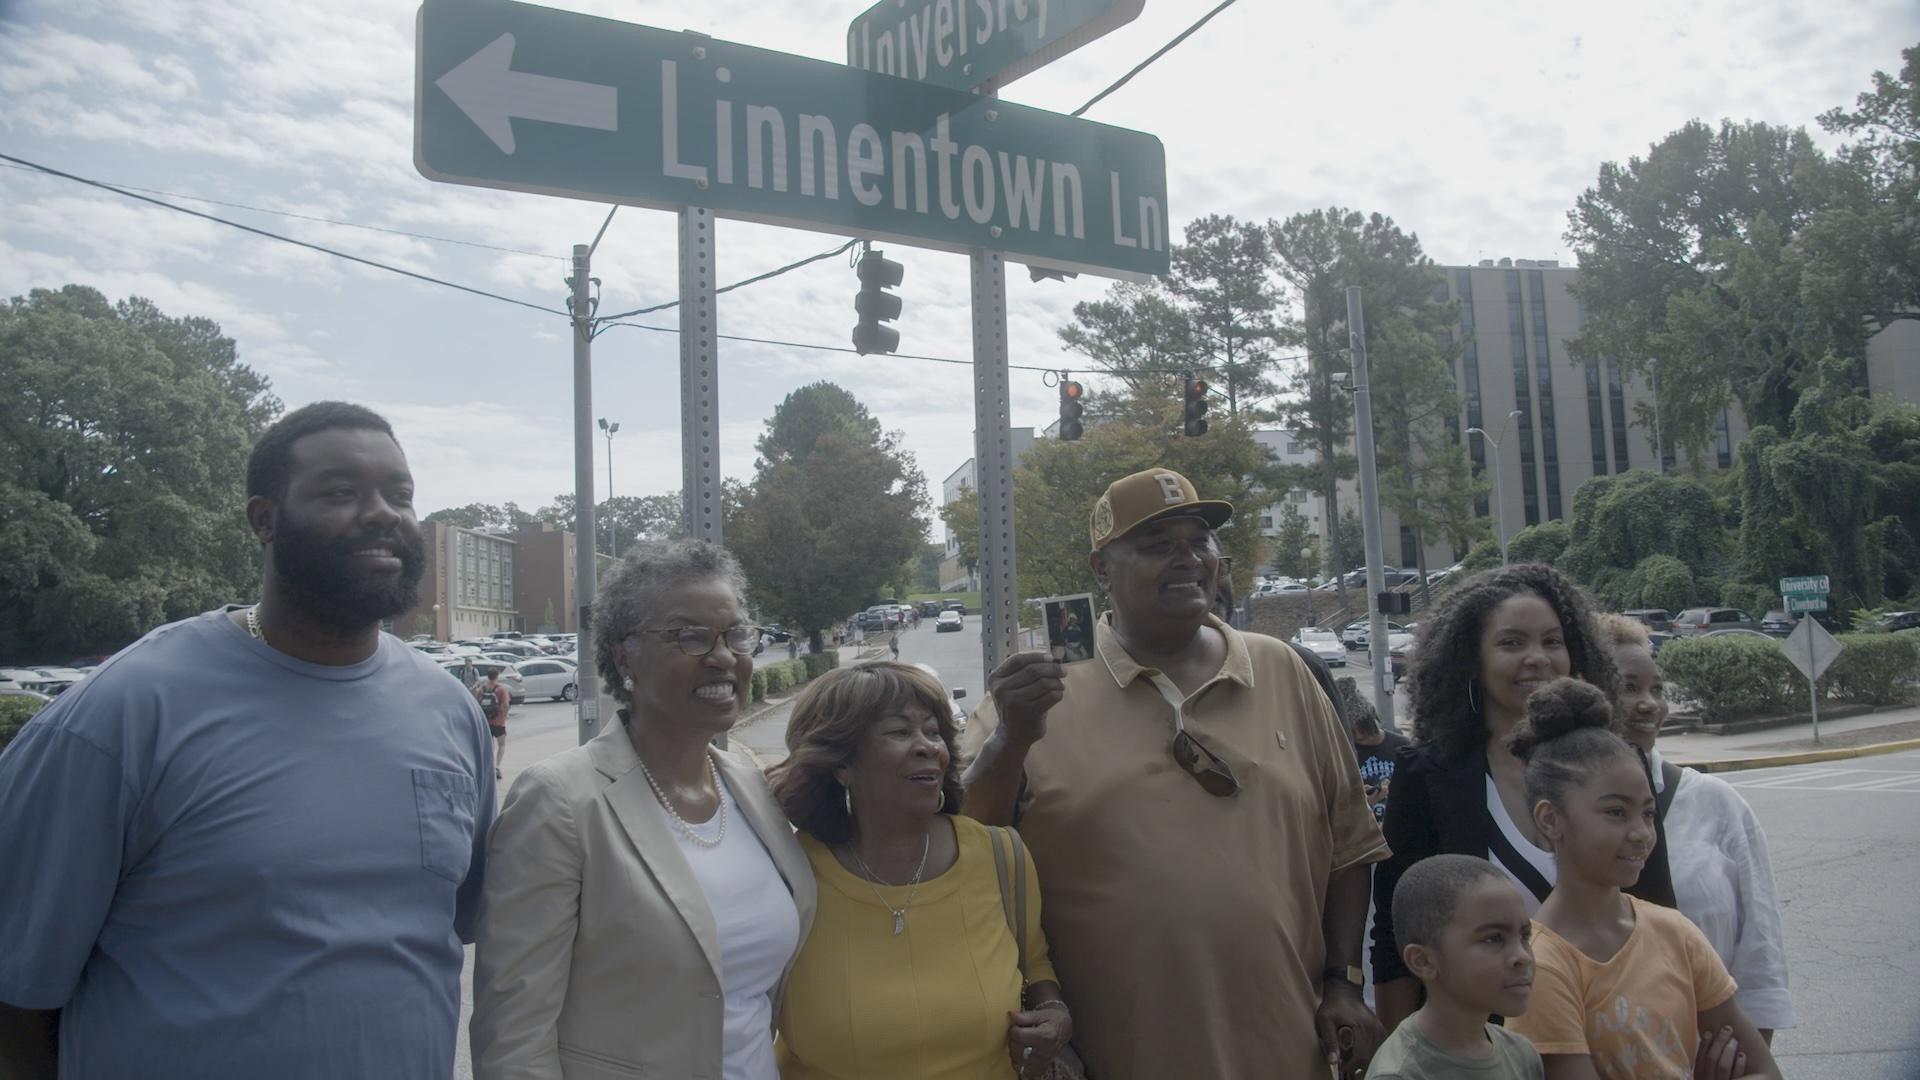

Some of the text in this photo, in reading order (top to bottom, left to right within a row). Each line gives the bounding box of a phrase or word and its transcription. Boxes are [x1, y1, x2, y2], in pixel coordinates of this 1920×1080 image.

[850, 0, 1047, 80] Univers
[662, 60, 1163, 252] Linnentown Ln
[1780, 578, 1818, 592] University
